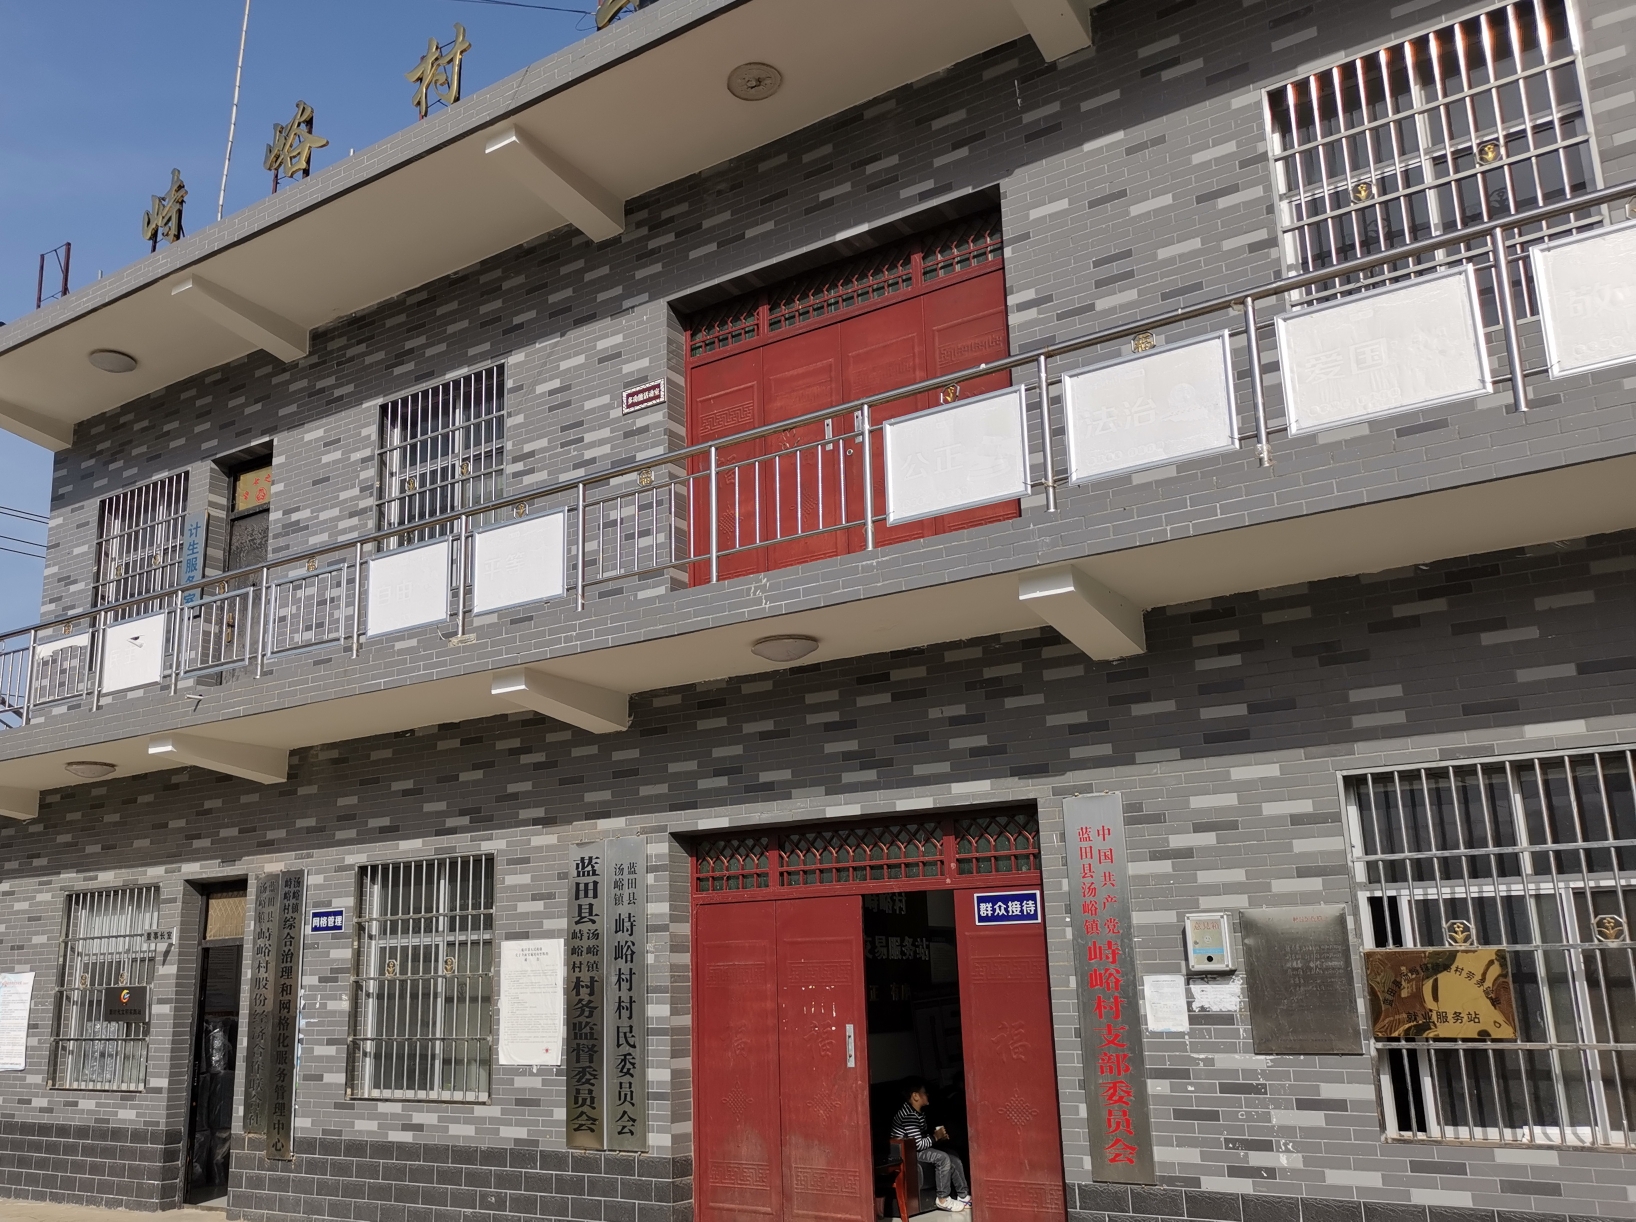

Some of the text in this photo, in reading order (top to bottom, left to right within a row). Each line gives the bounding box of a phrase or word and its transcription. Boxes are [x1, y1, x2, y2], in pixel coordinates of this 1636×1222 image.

[1305, 338, 1388, 384] 爱国
[1079, 396, 1158, 439] 法治
[901, 443, 964, 481] 公正
[484, 552, 525, 581] 平等
[572, 856, 600, 925] 蓝田县
[614, 863, 624, 906] 汤峪镇
[627, 862, 638, 905] 蓝田县
[1077, 826, 1100, 935] 蓝田县汤峪镇
[1097, 825, 1120, 935] 中国共产党
[312, 916, 342, 928] 网格管理
[979, 900, 1036, 917] 群众接待
[146, 931, 173, 941] 董事长室
[571, 929, 584, 973] 峙峪村
[586, 929, 600, 973] 汤峪镇
[272, 916, 296, 1151] 综合治理和网格化服务管理中心
[613, 913, 637, 1137] 峙峪村村民委员会
[1406, 1011, 1480, 1024] 就业服务站
[570, 976, 600, 1133] 村务监督委员会
[1087, 940, 1138, 1164] 峙峪村支部委员会
